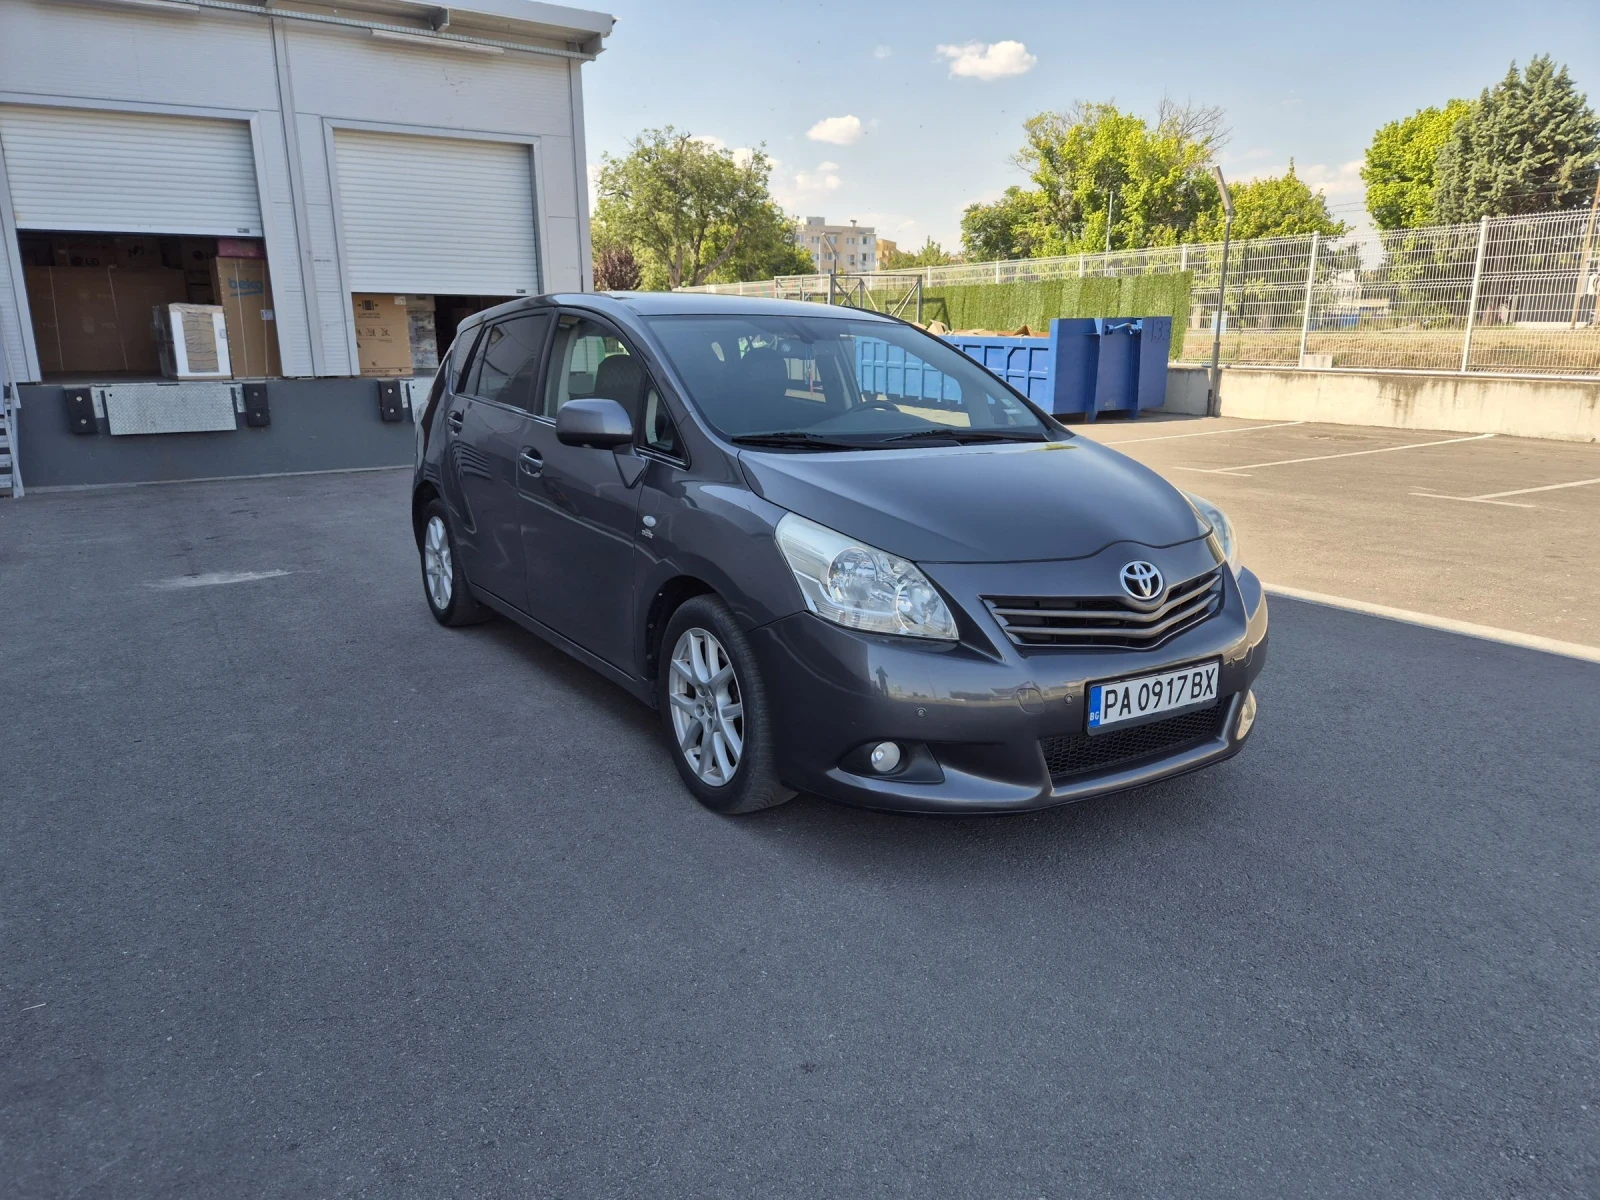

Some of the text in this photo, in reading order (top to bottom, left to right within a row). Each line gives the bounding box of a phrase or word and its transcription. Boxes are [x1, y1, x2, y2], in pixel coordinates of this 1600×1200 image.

[85, 257, 100, 266] LG
[228, 277, 264, 290] beko
[1104, 668, 1215, 719] PA 0917 BX
[1090, 711, 1099, 721] BG
